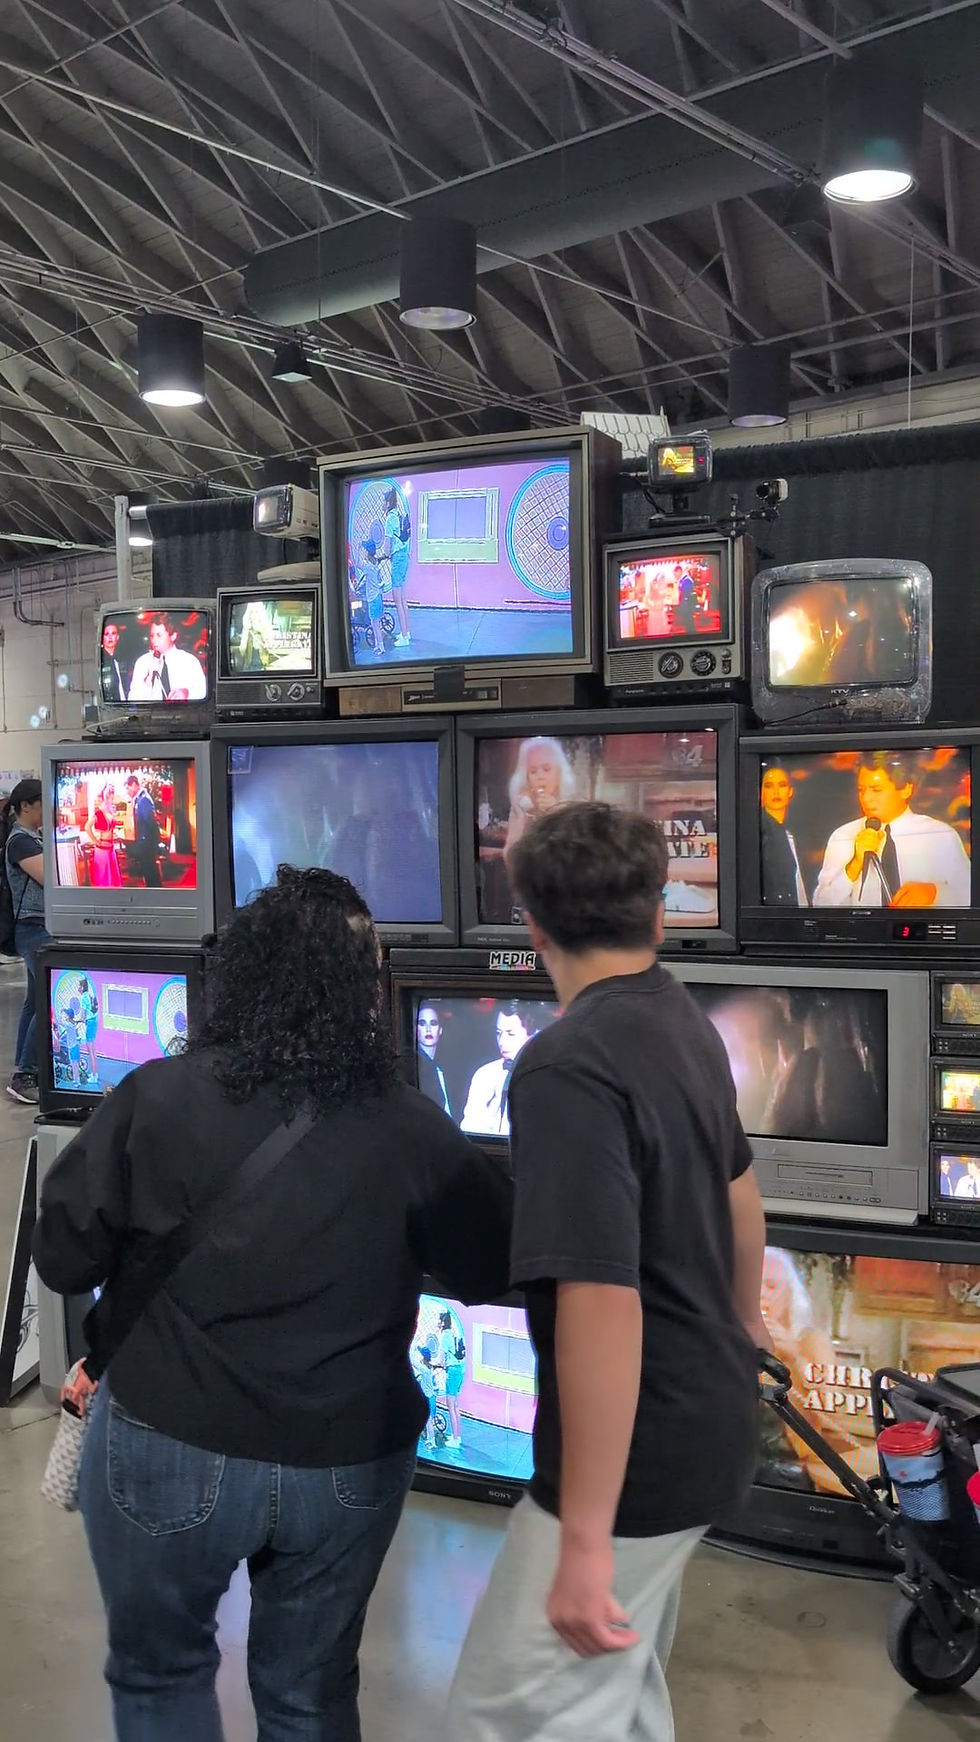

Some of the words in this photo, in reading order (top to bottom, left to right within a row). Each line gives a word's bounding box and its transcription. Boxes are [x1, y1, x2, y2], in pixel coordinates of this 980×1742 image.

[655, 819, 707, 837] INA
[902, 926, 910, 937] 3
[490, 952, 535, 967] MEDIA
